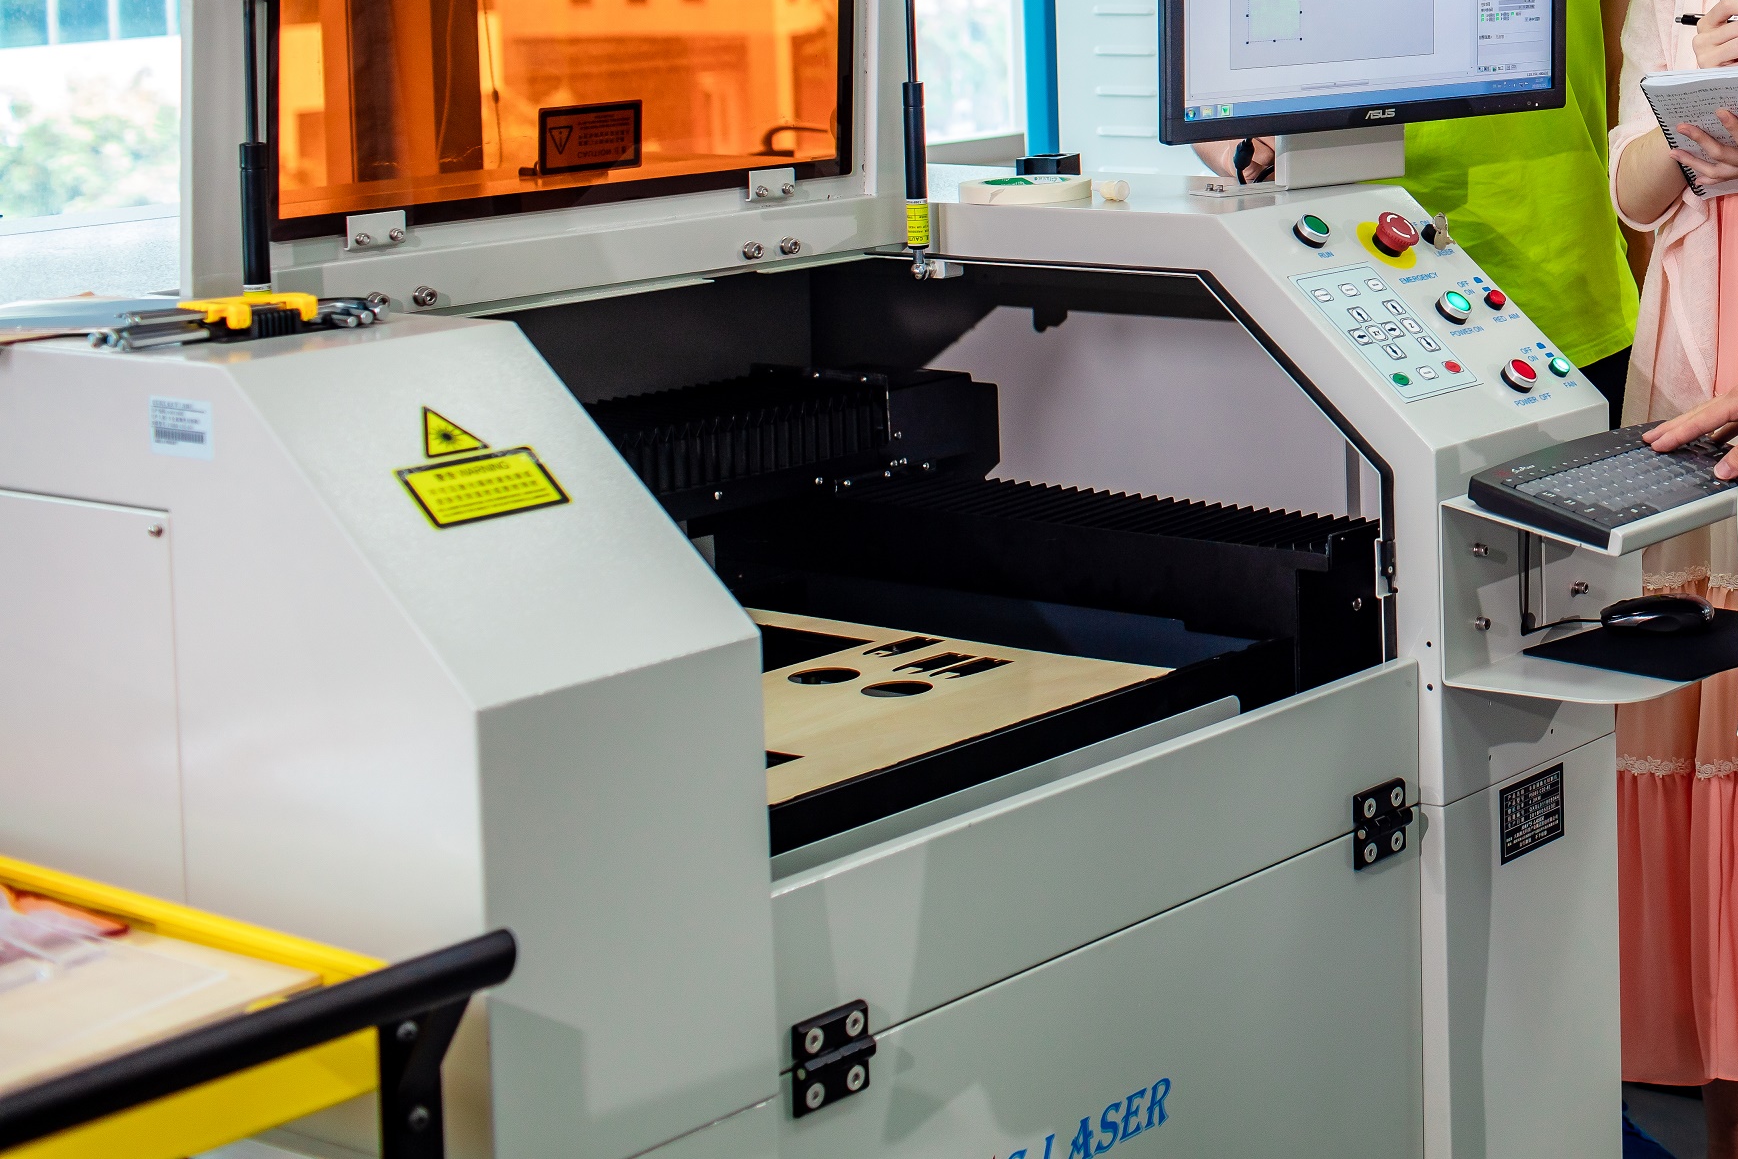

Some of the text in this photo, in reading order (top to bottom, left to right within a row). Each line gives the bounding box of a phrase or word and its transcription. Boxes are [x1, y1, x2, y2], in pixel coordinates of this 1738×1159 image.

[1365, 108, 1396, 120] ASUS
[1317, 250, 1335, 260] RUN
[1399, 272, 1439, 285] EMERGENCY
[1456, 280, 1470, 288] OFF
[1464, 288, 1476, 296] ON
[1492, 312, 1521, 323] RED AIM
[1449, 325, 1485, 338] POWER ON
[1520, 346, 1533, 355] OFF
[1527, 354, 1540, 363] ON
[1563, 380, 1578, 389] FAN
[1514, 392, 1552, 408] POWER OFF
[459, 460, 510, 477] WARNING
